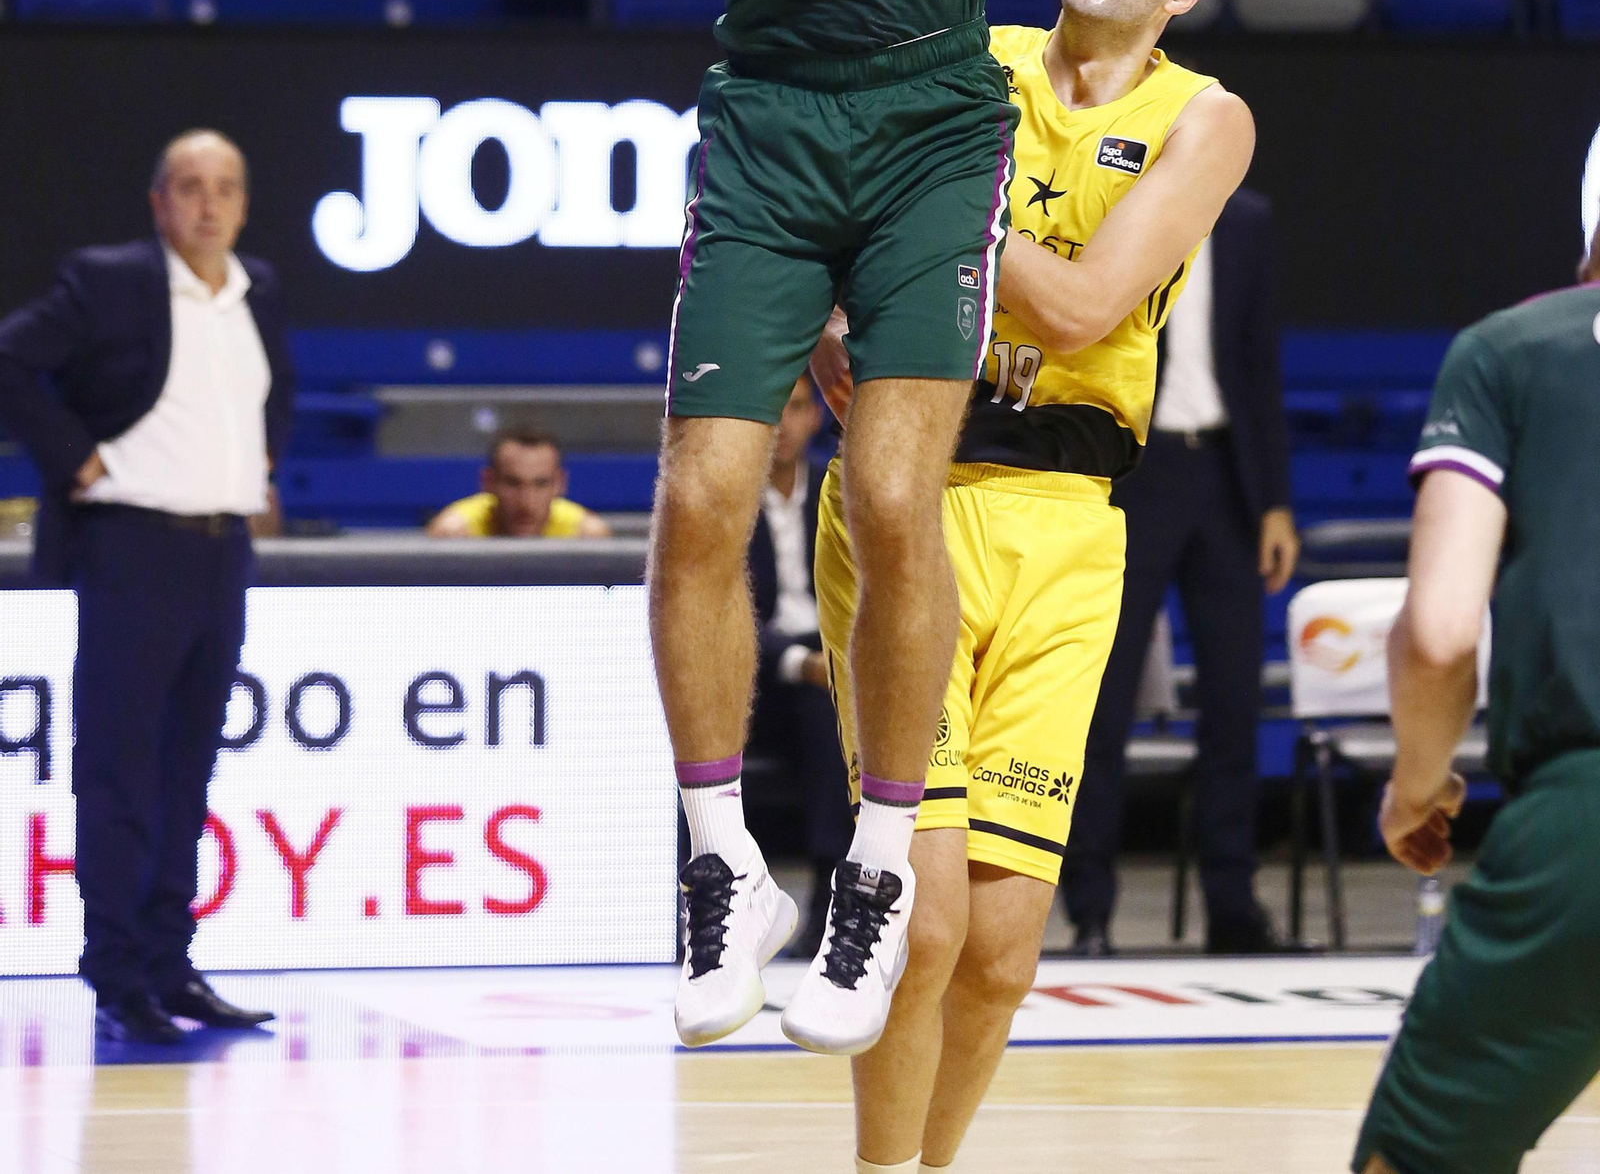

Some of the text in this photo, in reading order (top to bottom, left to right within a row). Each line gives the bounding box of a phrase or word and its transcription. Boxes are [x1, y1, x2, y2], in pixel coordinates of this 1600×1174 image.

[1100, 155, 1141, 171] endesa
[1102, 145, 1123, 156] liga
[960, 274, 975, 286] acb
[989, 341, 1043, 413] 19
[403, 669, 549, 748] en
[972, 766, 1046, 797] Canarias
[1008, 757, 1050, 782] Islas
